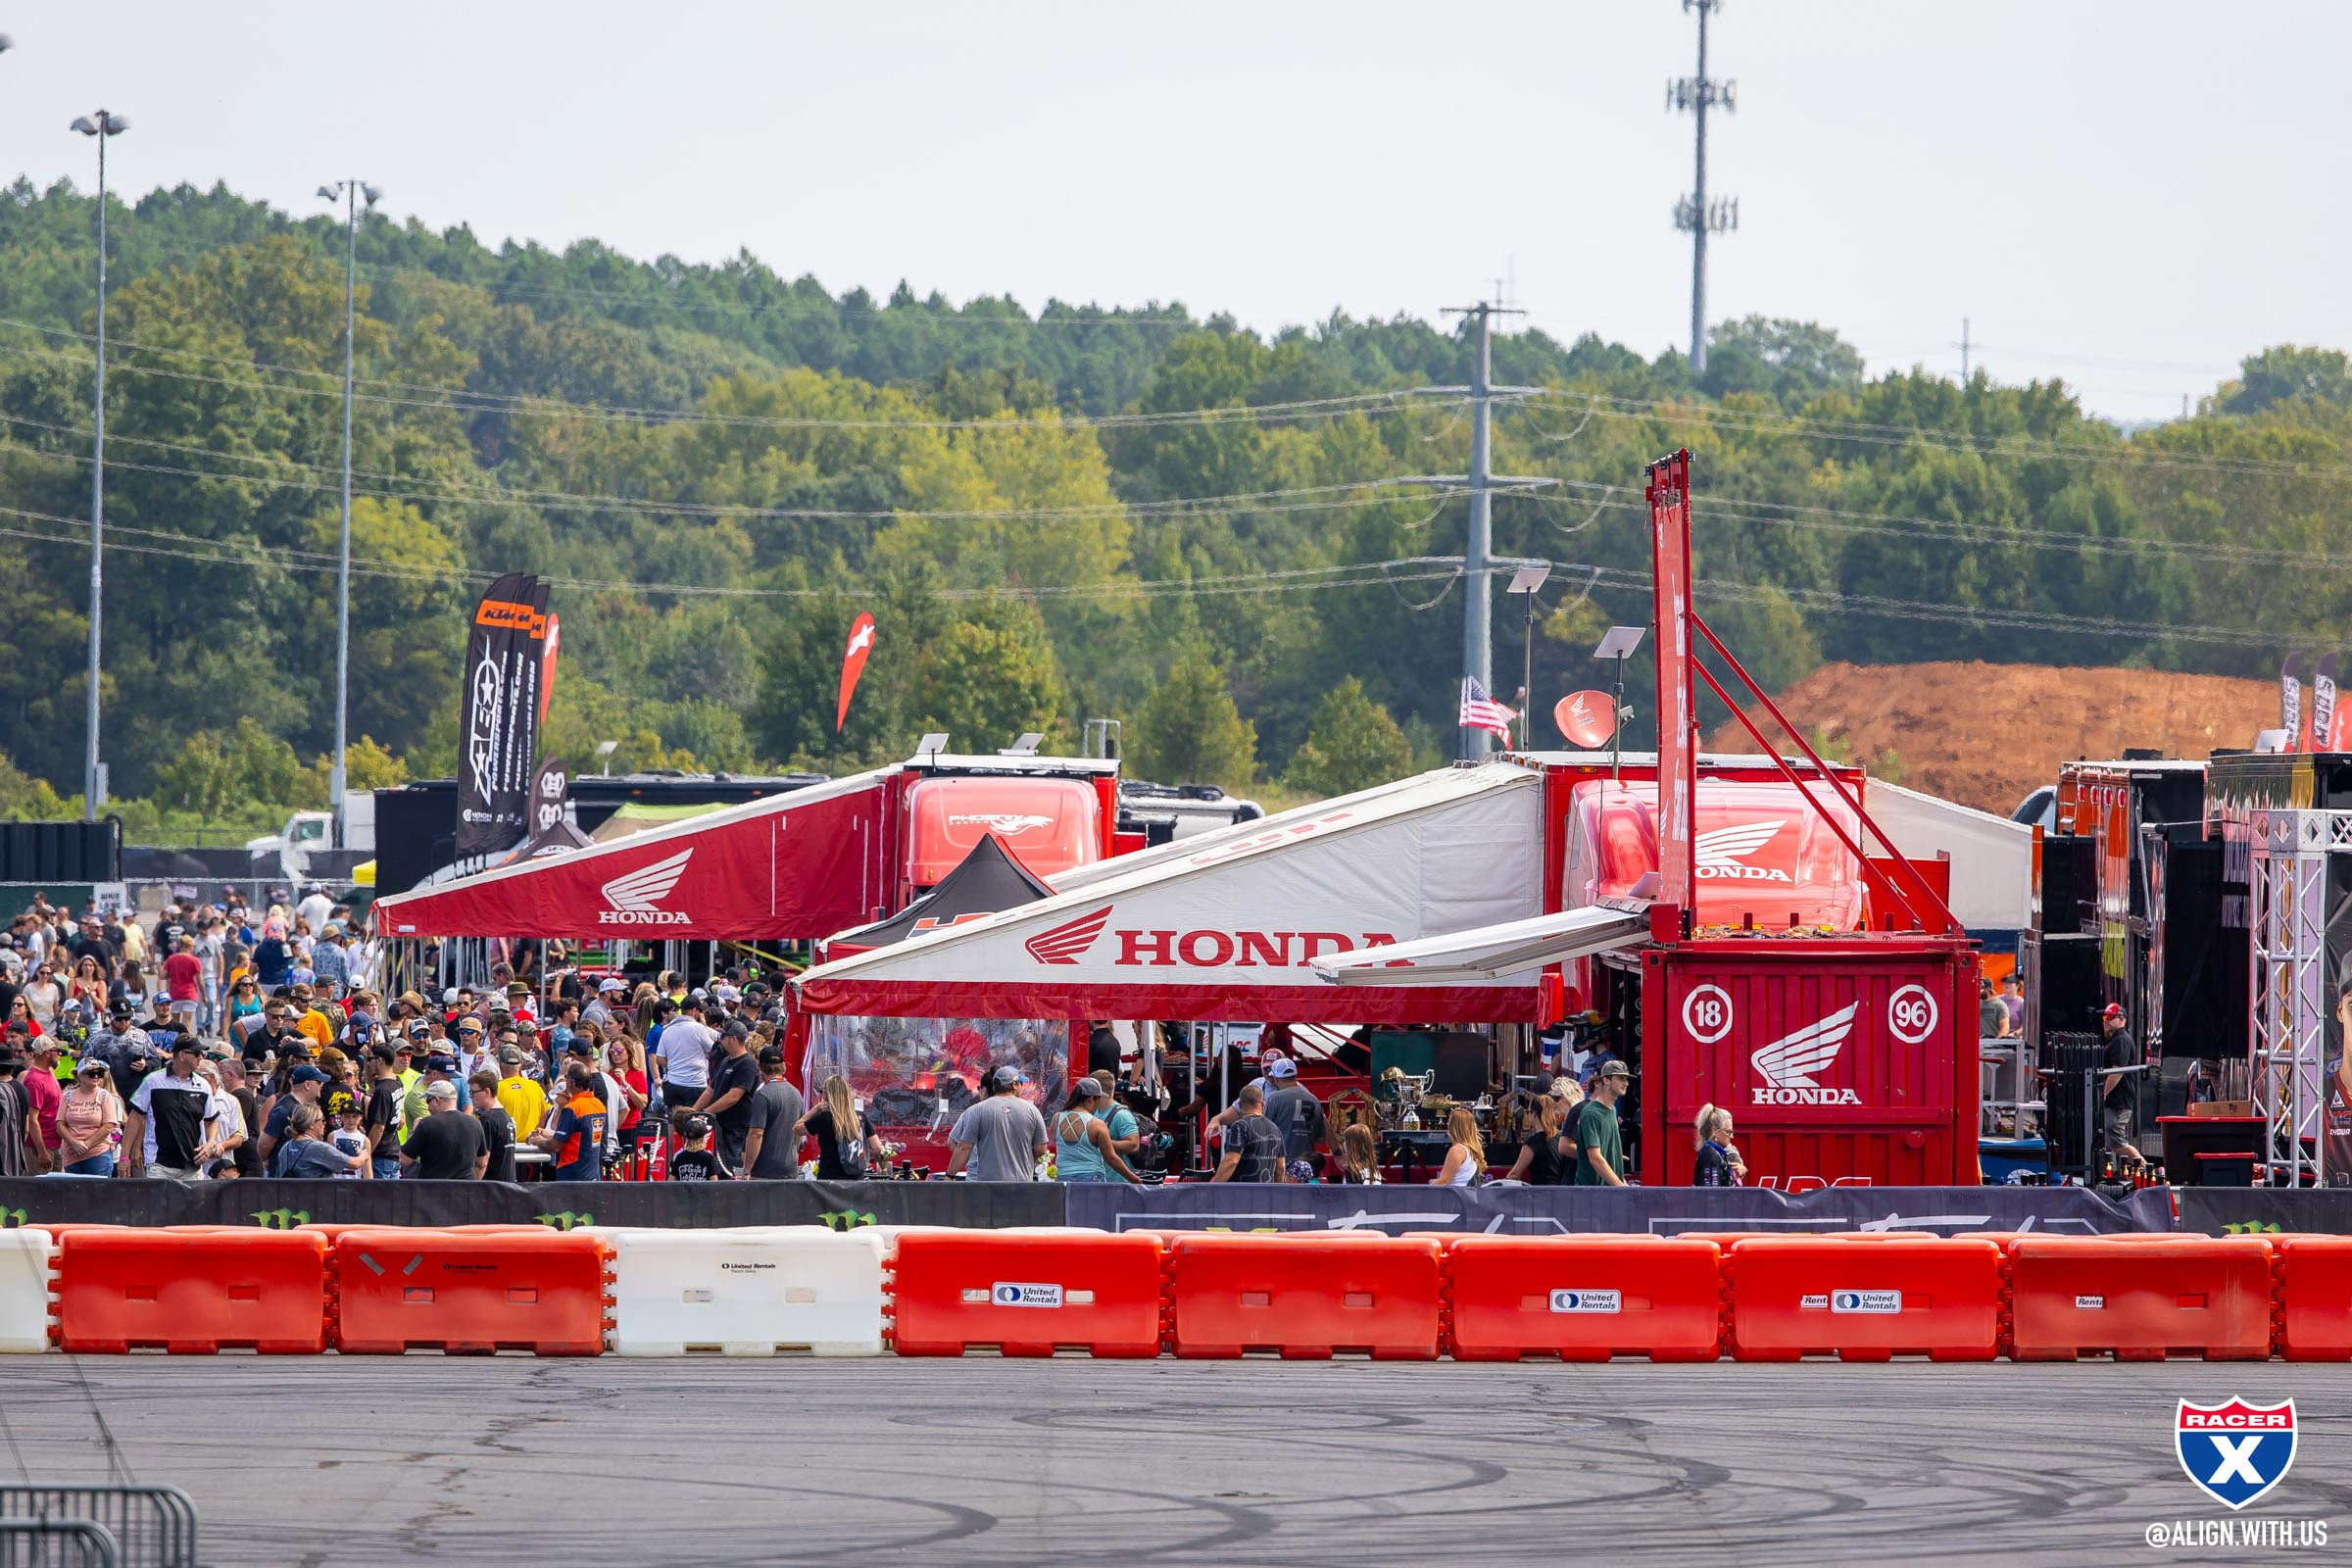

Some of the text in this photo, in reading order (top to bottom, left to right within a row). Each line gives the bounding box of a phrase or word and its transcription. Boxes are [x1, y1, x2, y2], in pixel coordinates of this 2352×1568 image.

[1695, 866, 1793, 882] ONDA
[598, 911, 693, 924] HONDA
[1695, 1001, 1722, 1027] 18
[1895, 1001, 1927, 1027] 96
[1752, 1088, 1862, 1105] HONDA
[1022, 1296, 1057, 1304] Rentals
[1862, 1294, 1894, 1302] United
[1862, 1301, 1896, 1310] Rentals
